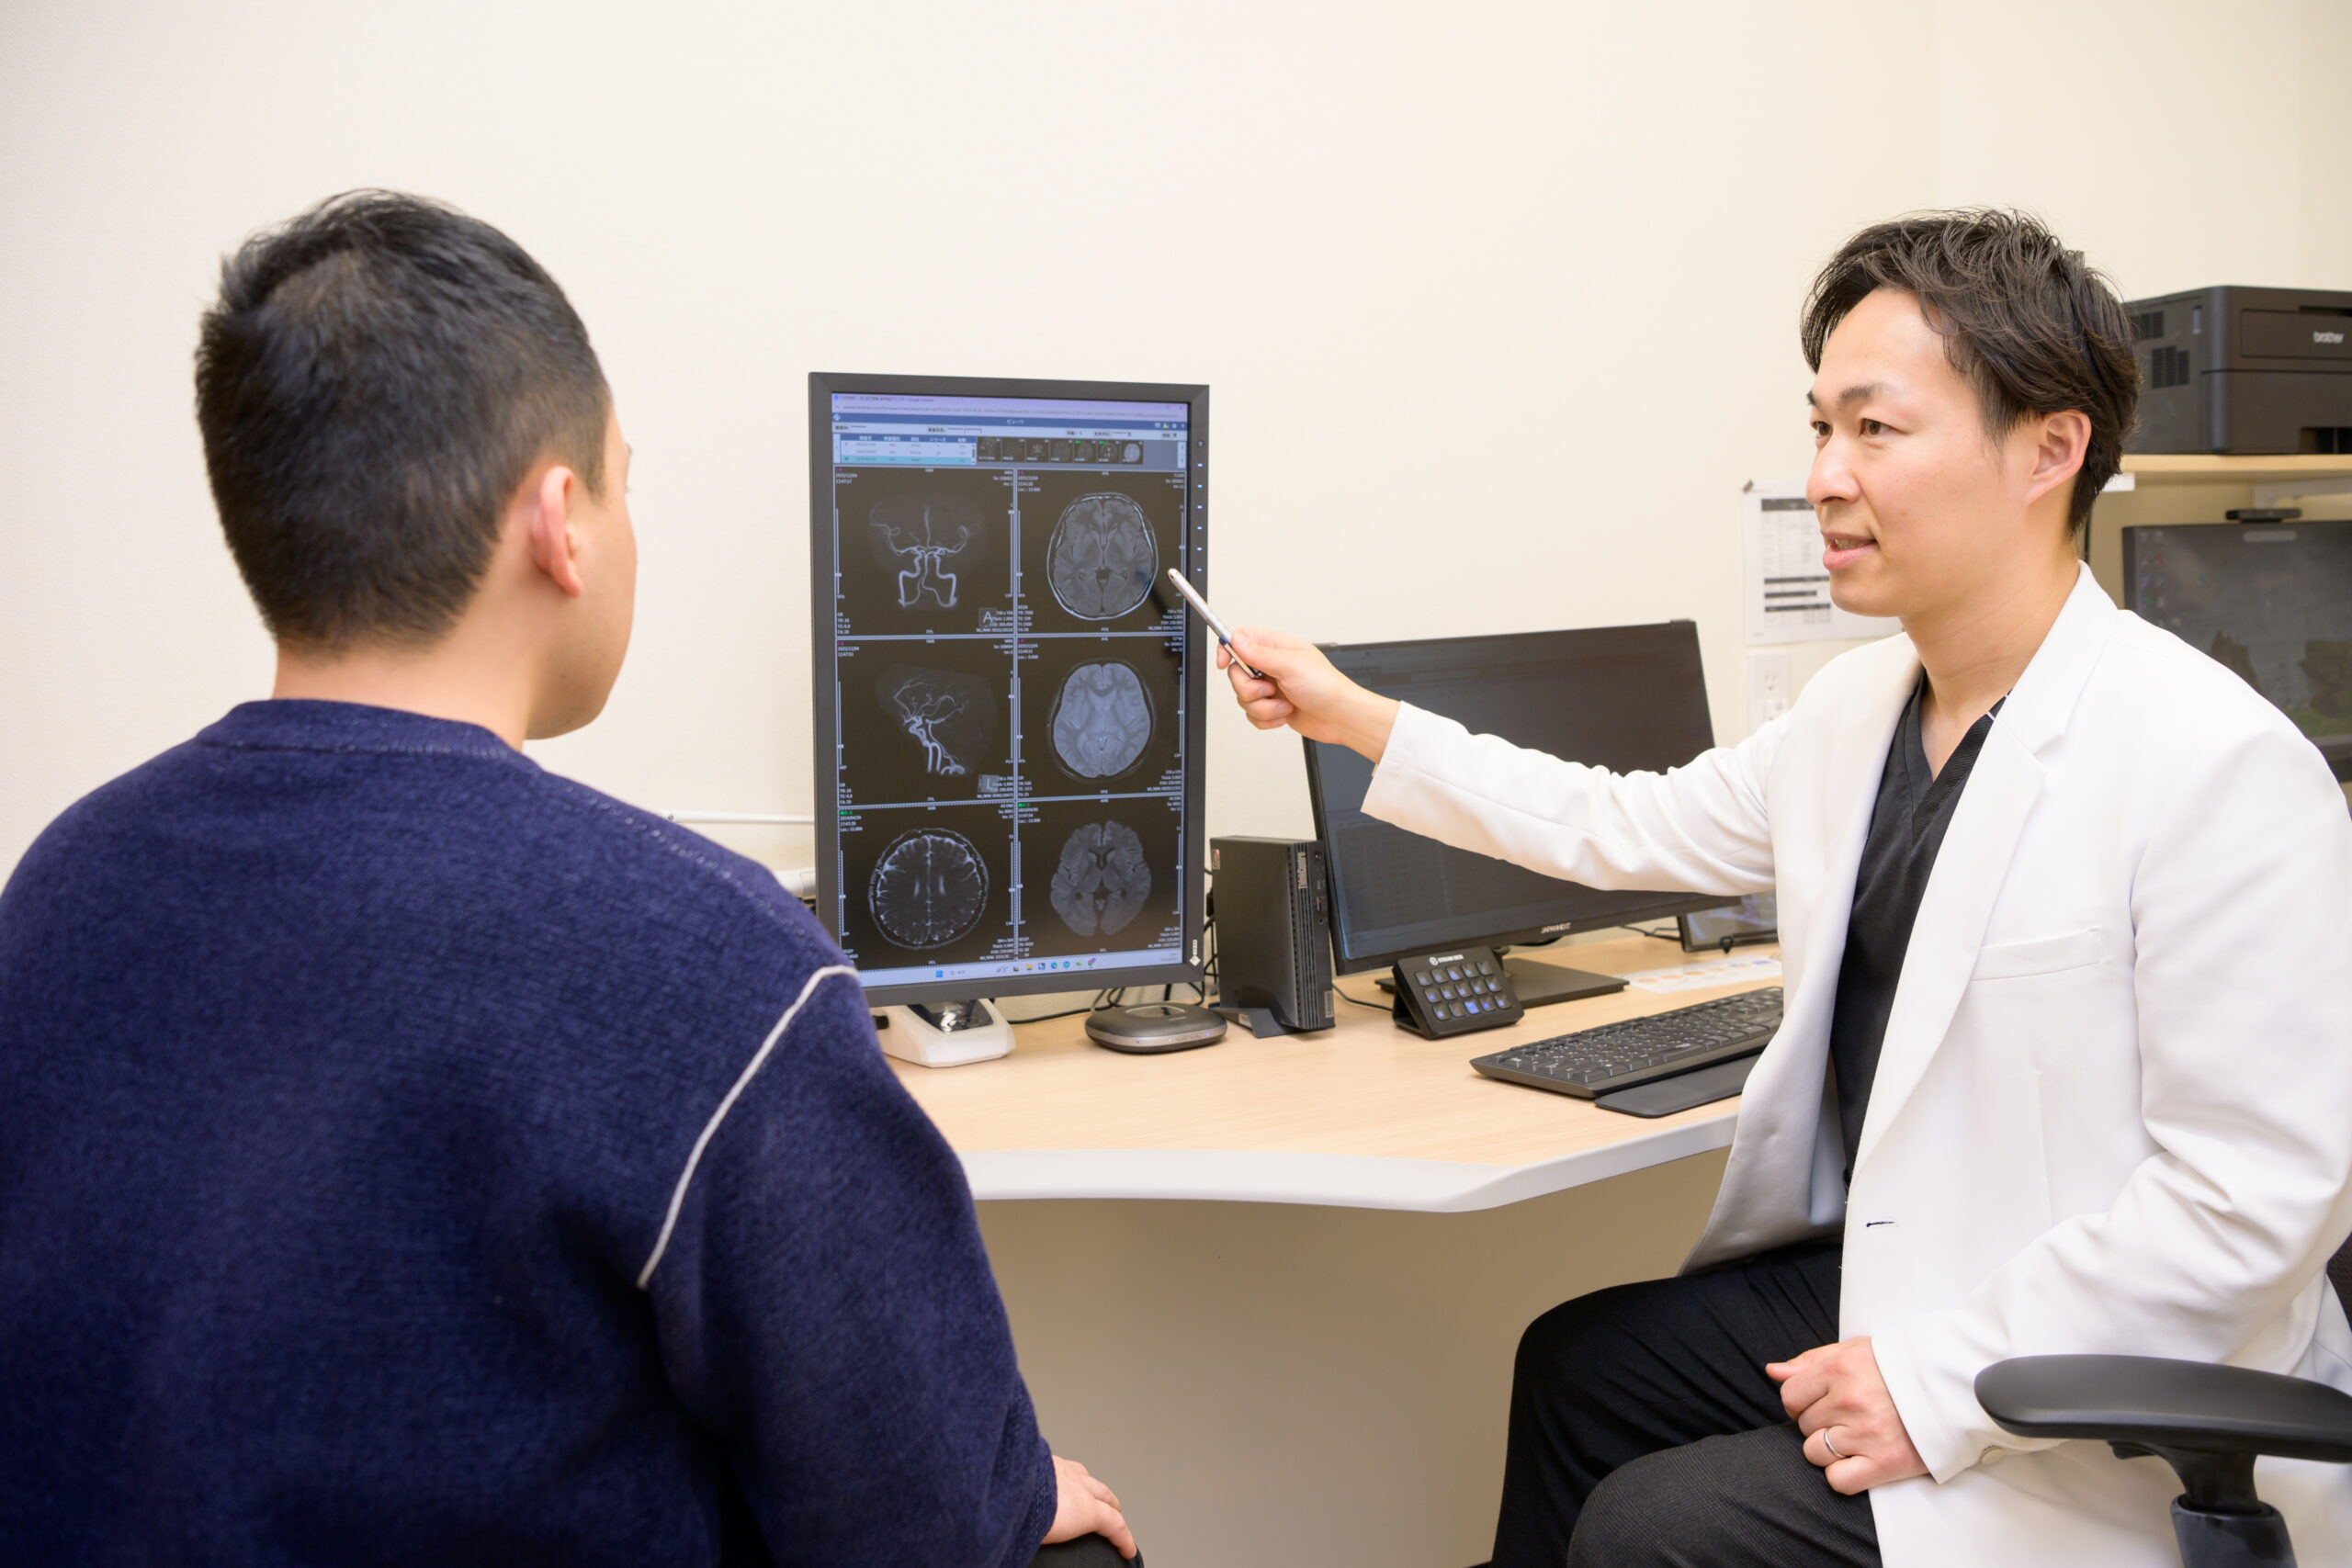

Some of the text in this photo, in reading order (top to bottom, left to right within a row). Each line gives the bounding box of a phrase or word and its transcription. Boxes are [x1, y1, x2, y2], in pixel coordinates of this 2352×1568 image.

[2312, 331, 2344, 344] brother
[982, 611, 993, 623] A
[1297, 852, 1308, 890] ThinkCentre
